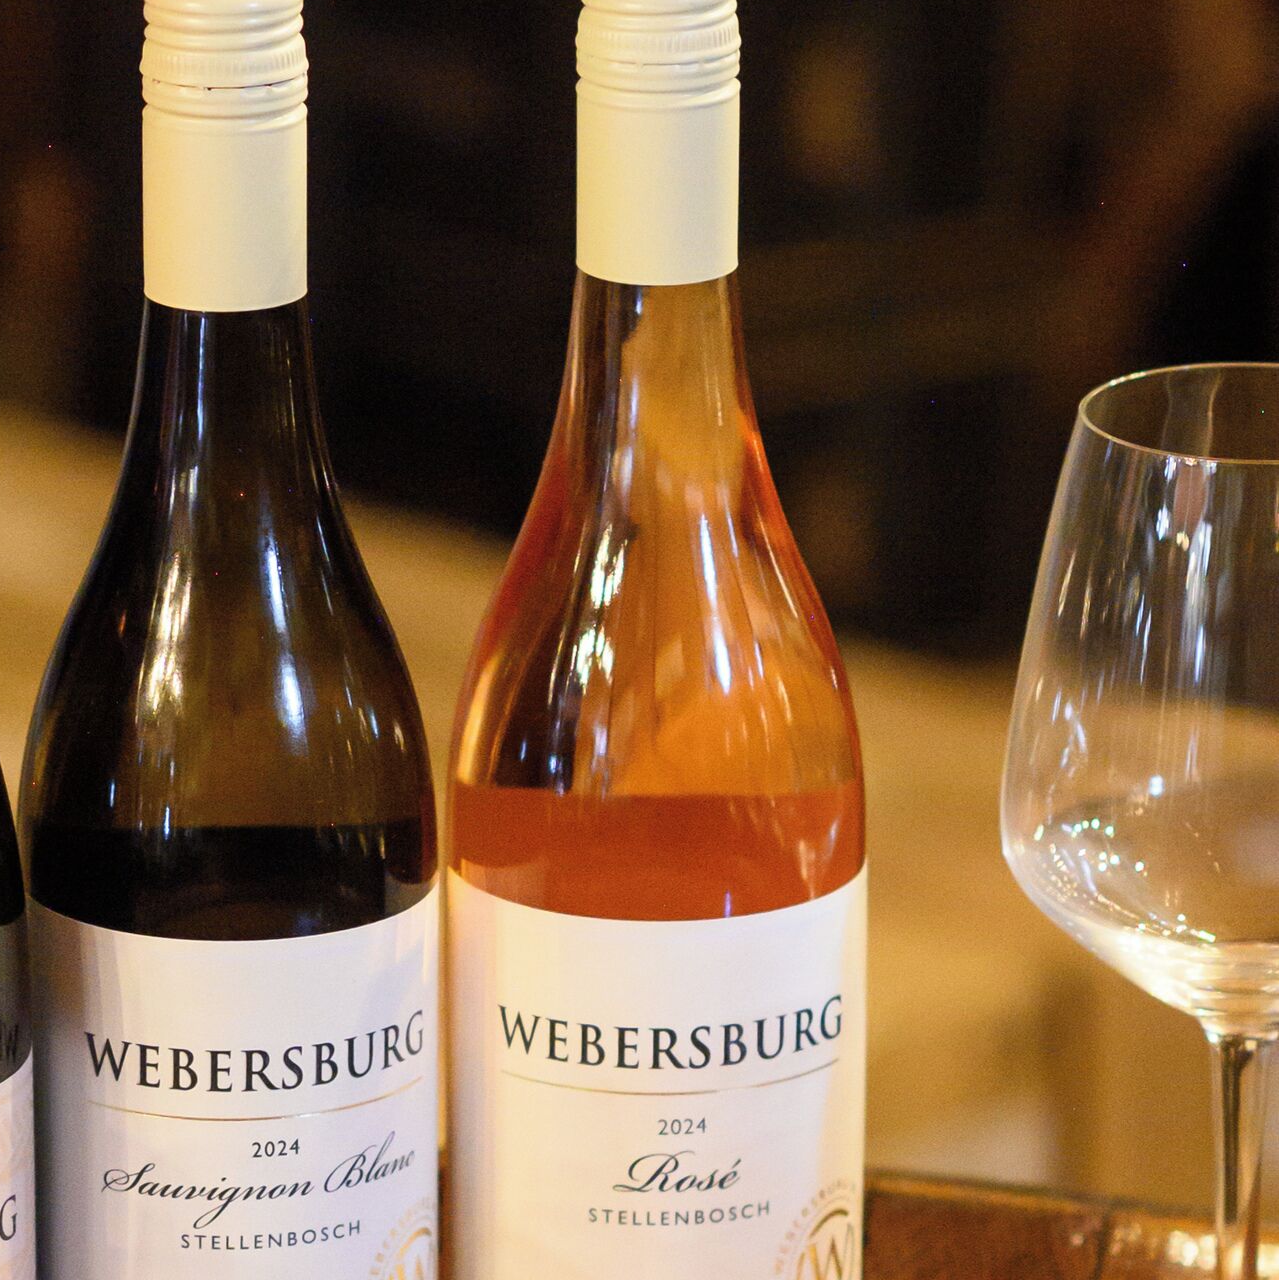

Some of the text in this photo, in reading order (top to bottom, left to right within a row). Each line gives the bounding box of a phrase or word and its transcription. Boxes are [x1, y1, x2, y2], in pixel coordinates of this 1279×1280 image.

[497, 994, 842, 1070] WEBERSBURG
[83, 1010, 423, 1093] WEBERSBURG
[657, 1117, 707, 1136] 2024
[251, 1139, 301, 1158] 2024
[101, 1130, 416, 1229] Sauvignon Blanc
[612, 1150, 742, 1194] Rosé
[588, 1200, 771, 1226] STELLENBOSCH
[181, 1220, 361, 1250] STELLENBOSCH
